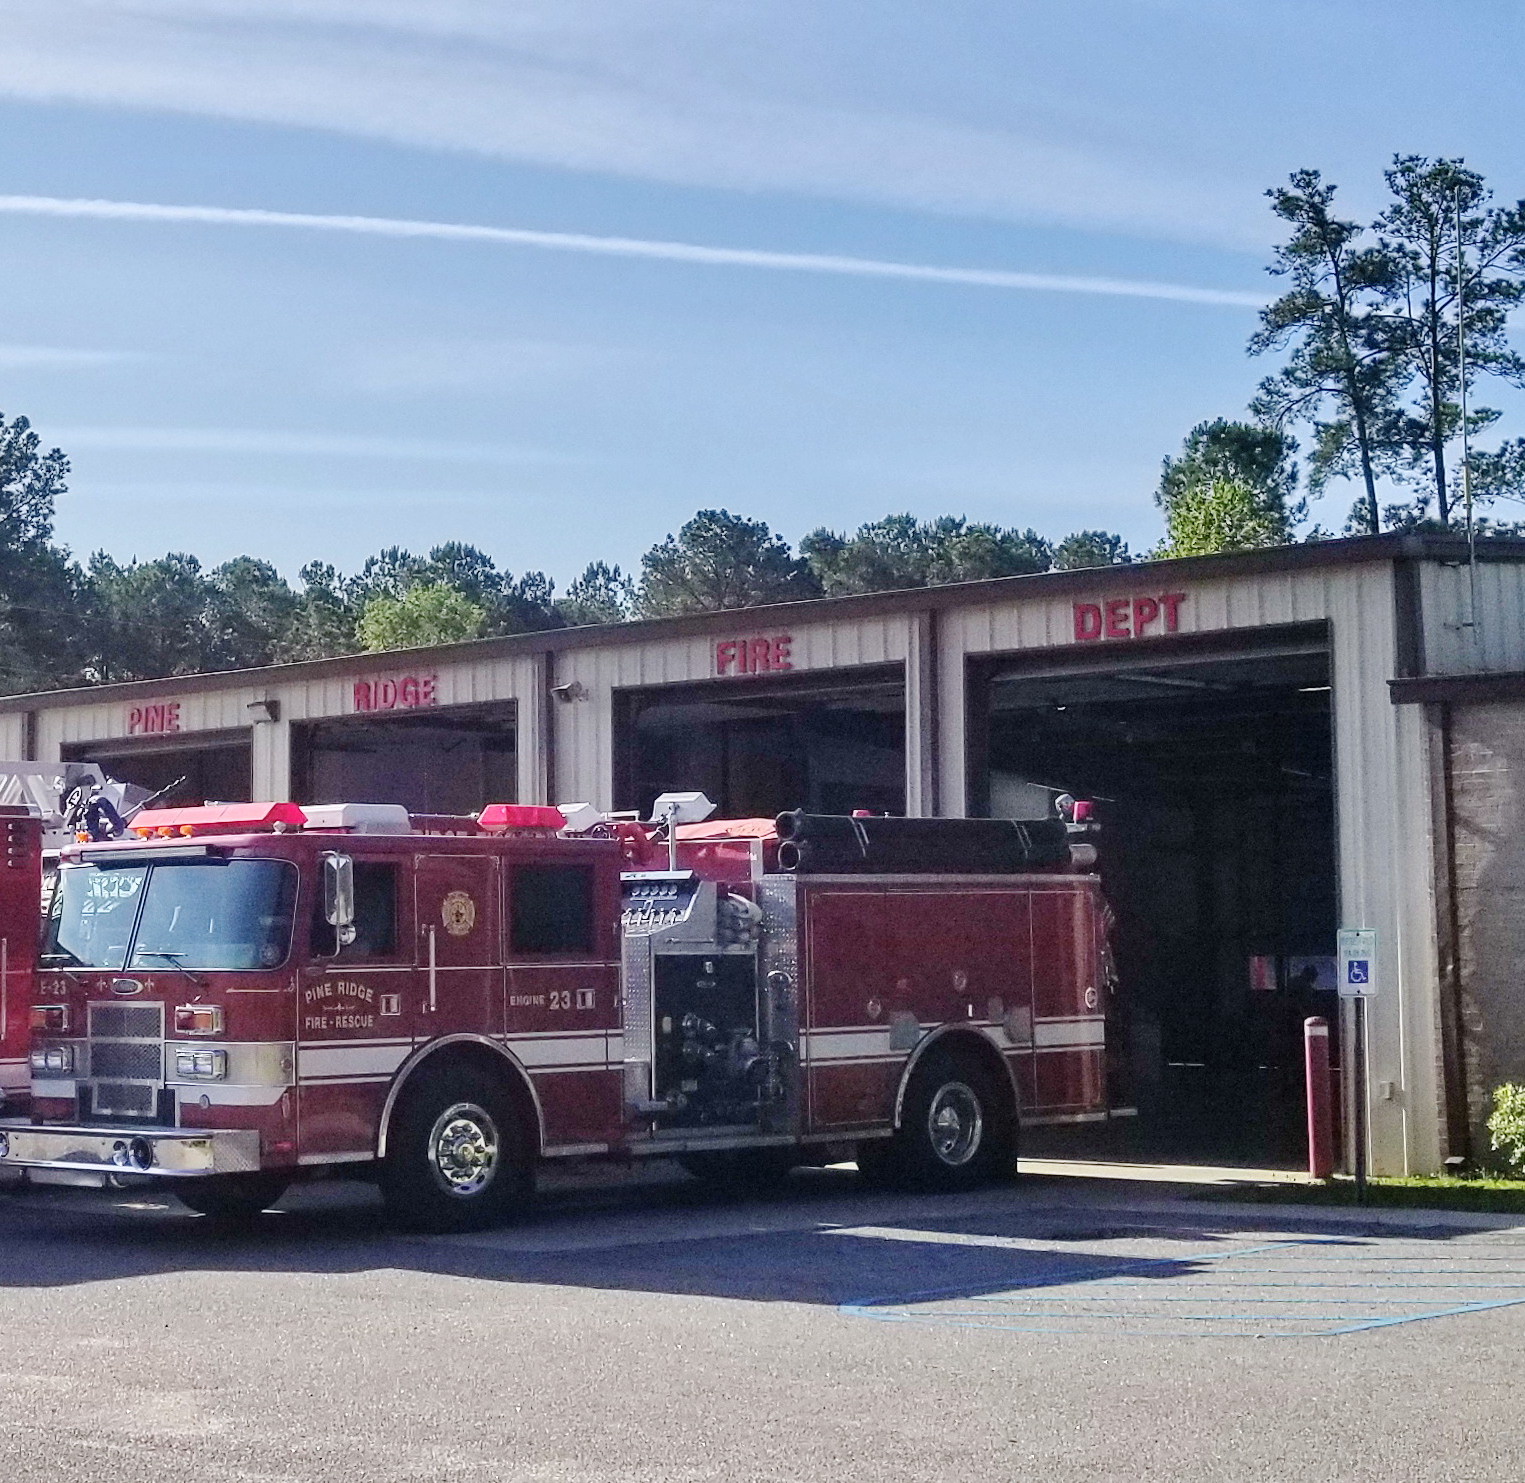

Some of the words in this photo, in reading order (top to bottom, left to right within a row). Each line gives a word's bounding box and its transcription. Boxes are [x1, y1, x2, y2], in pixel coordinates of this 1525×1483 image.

[127, 703, 181, 734] PINE
[353, 676, 438, 713] RIDGE
[716, 637, 793, 676] FIRE
[1073, 593, 1186, 641] DEPT
[304, 983, 333, 1004] PINE
[338, 981, 374, 1003] RIDGE
[509, 994, 545, 1006] ENGINE
[549, 990, 571, 1010] 23
